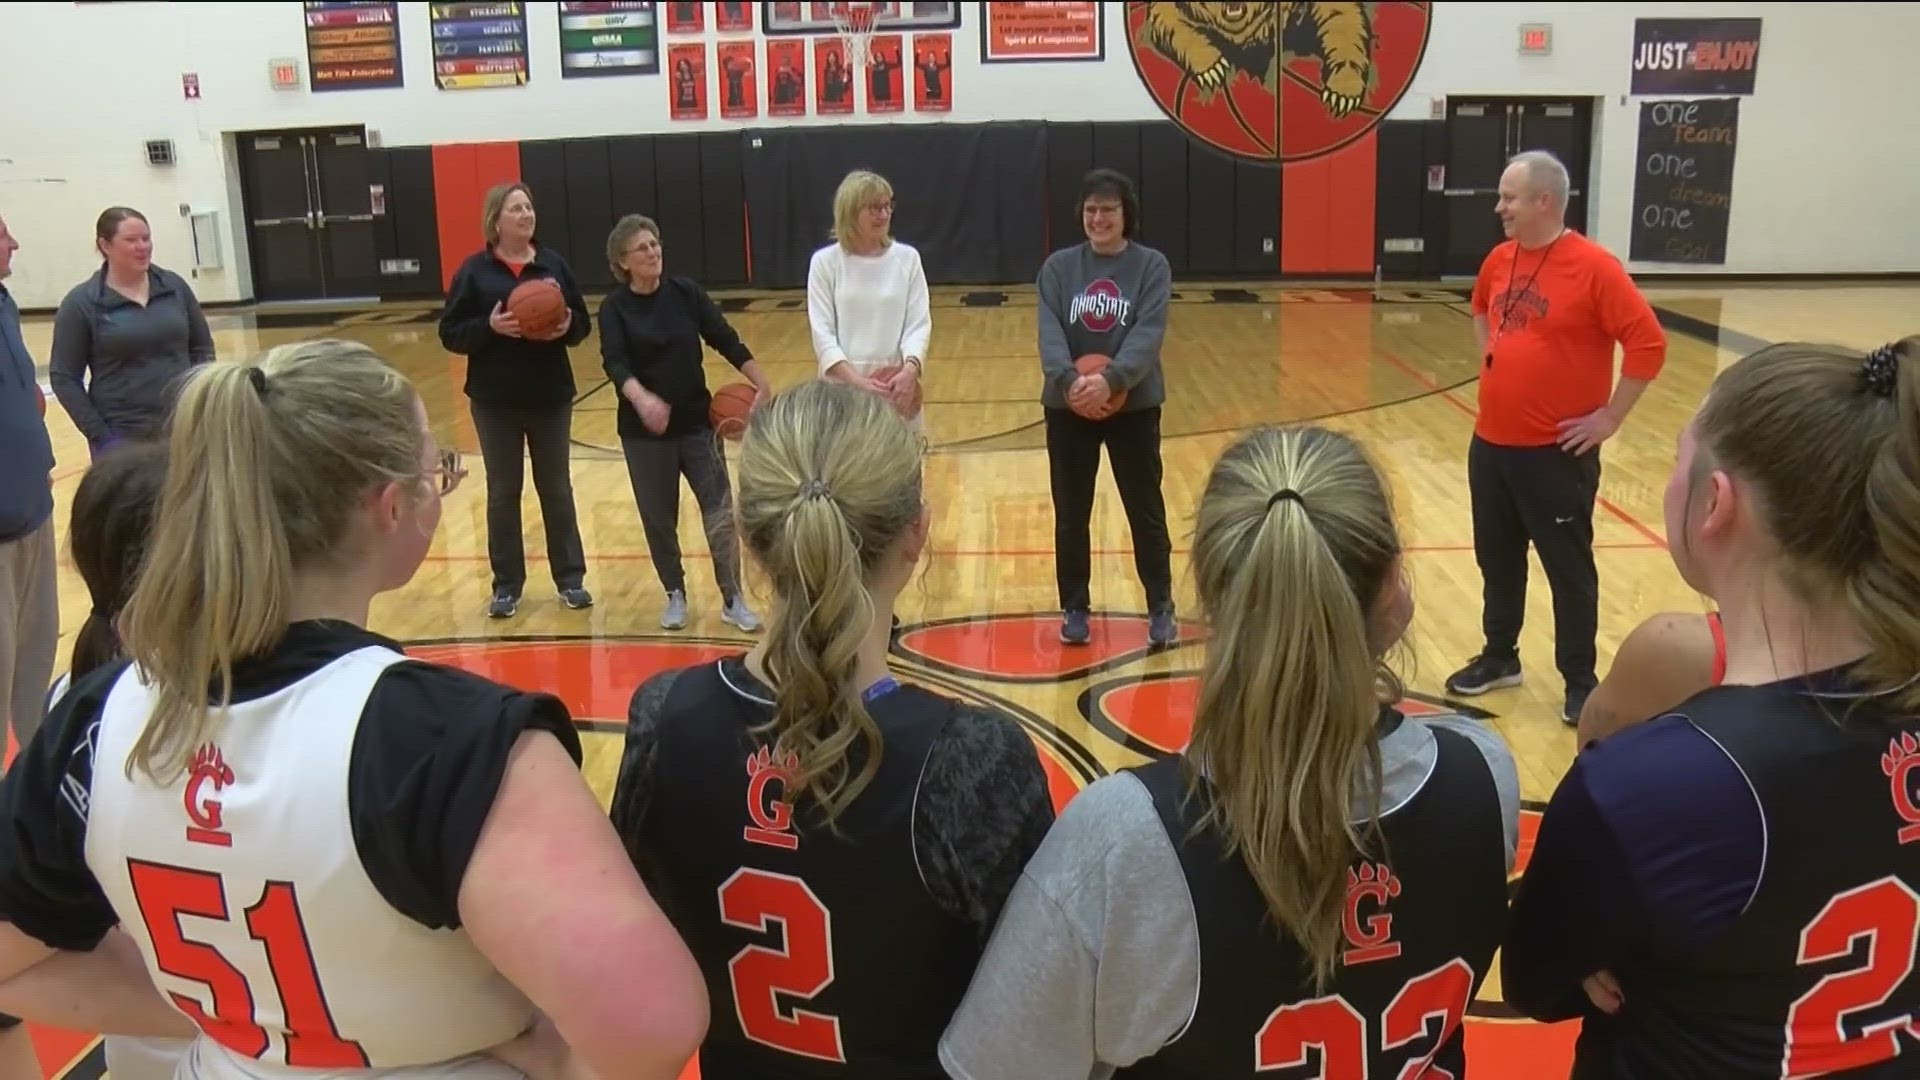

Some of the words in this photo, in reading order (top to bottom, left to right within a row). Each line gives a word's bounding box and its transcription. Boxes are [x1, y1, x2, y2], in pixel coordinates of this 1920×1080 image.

[1004, 35, 1026, 47] Spirit
[1028, 35, 1037, 45] of
[1038, 34, 1089, 46] Competition
[1634, 42, 1688, 71] JUST
[1694, 41, 1757, 72] ENJOY
[1672, 123, 1733, 145] Team
[127, 857, 372, 1069] 51
[717, 866, 847, 1064] 2
[1781, 874, 1920, 1080] 2
